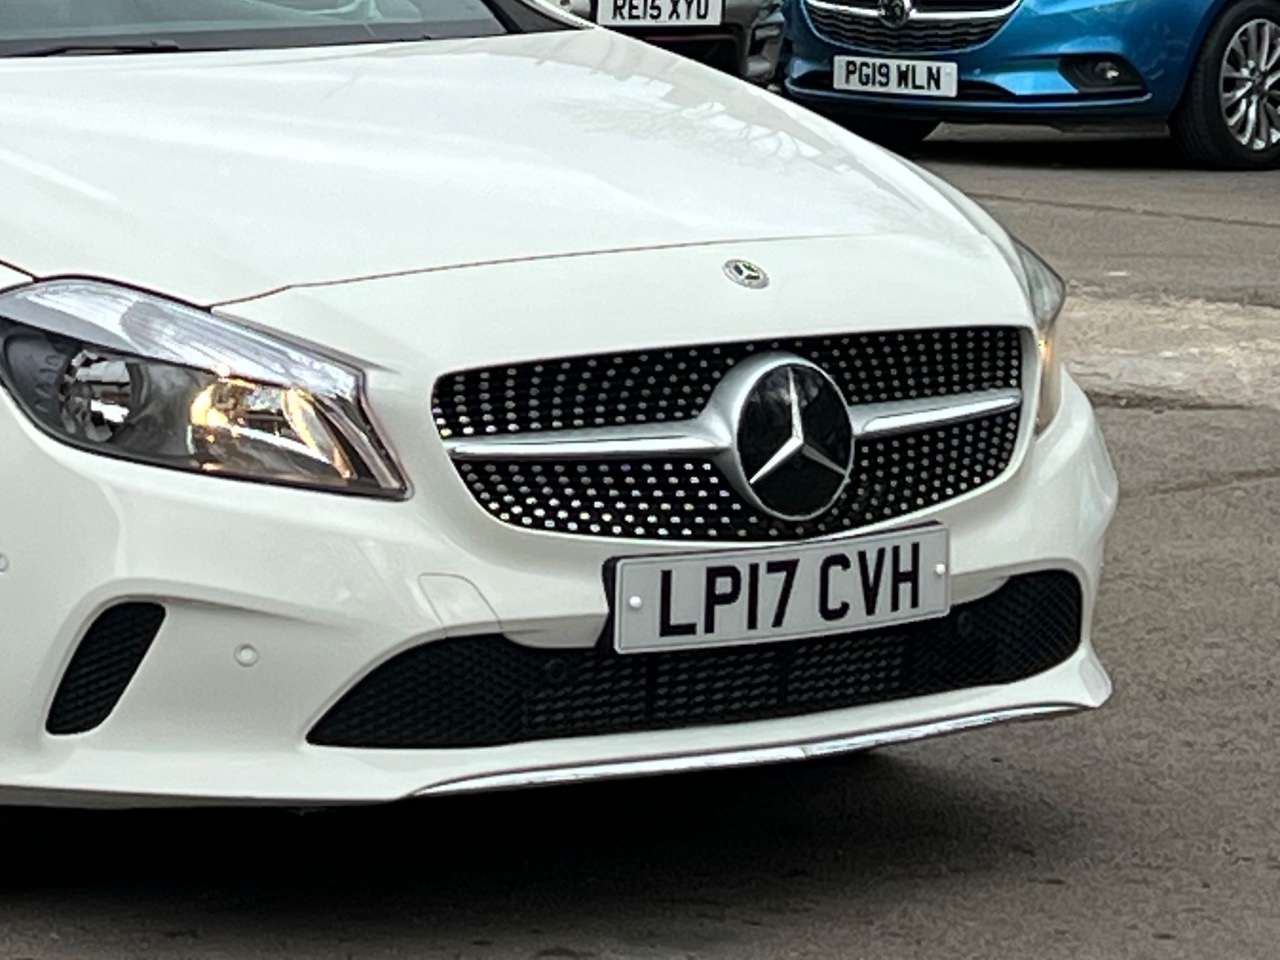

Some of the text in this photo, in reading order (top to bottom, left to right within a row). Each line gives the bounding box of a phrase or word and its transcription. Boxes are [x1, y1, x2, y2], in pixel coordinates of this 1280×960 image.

[845, 60, 942, 91] PG19 WLN
[658, 541, 920, 638] LP17 CVH
